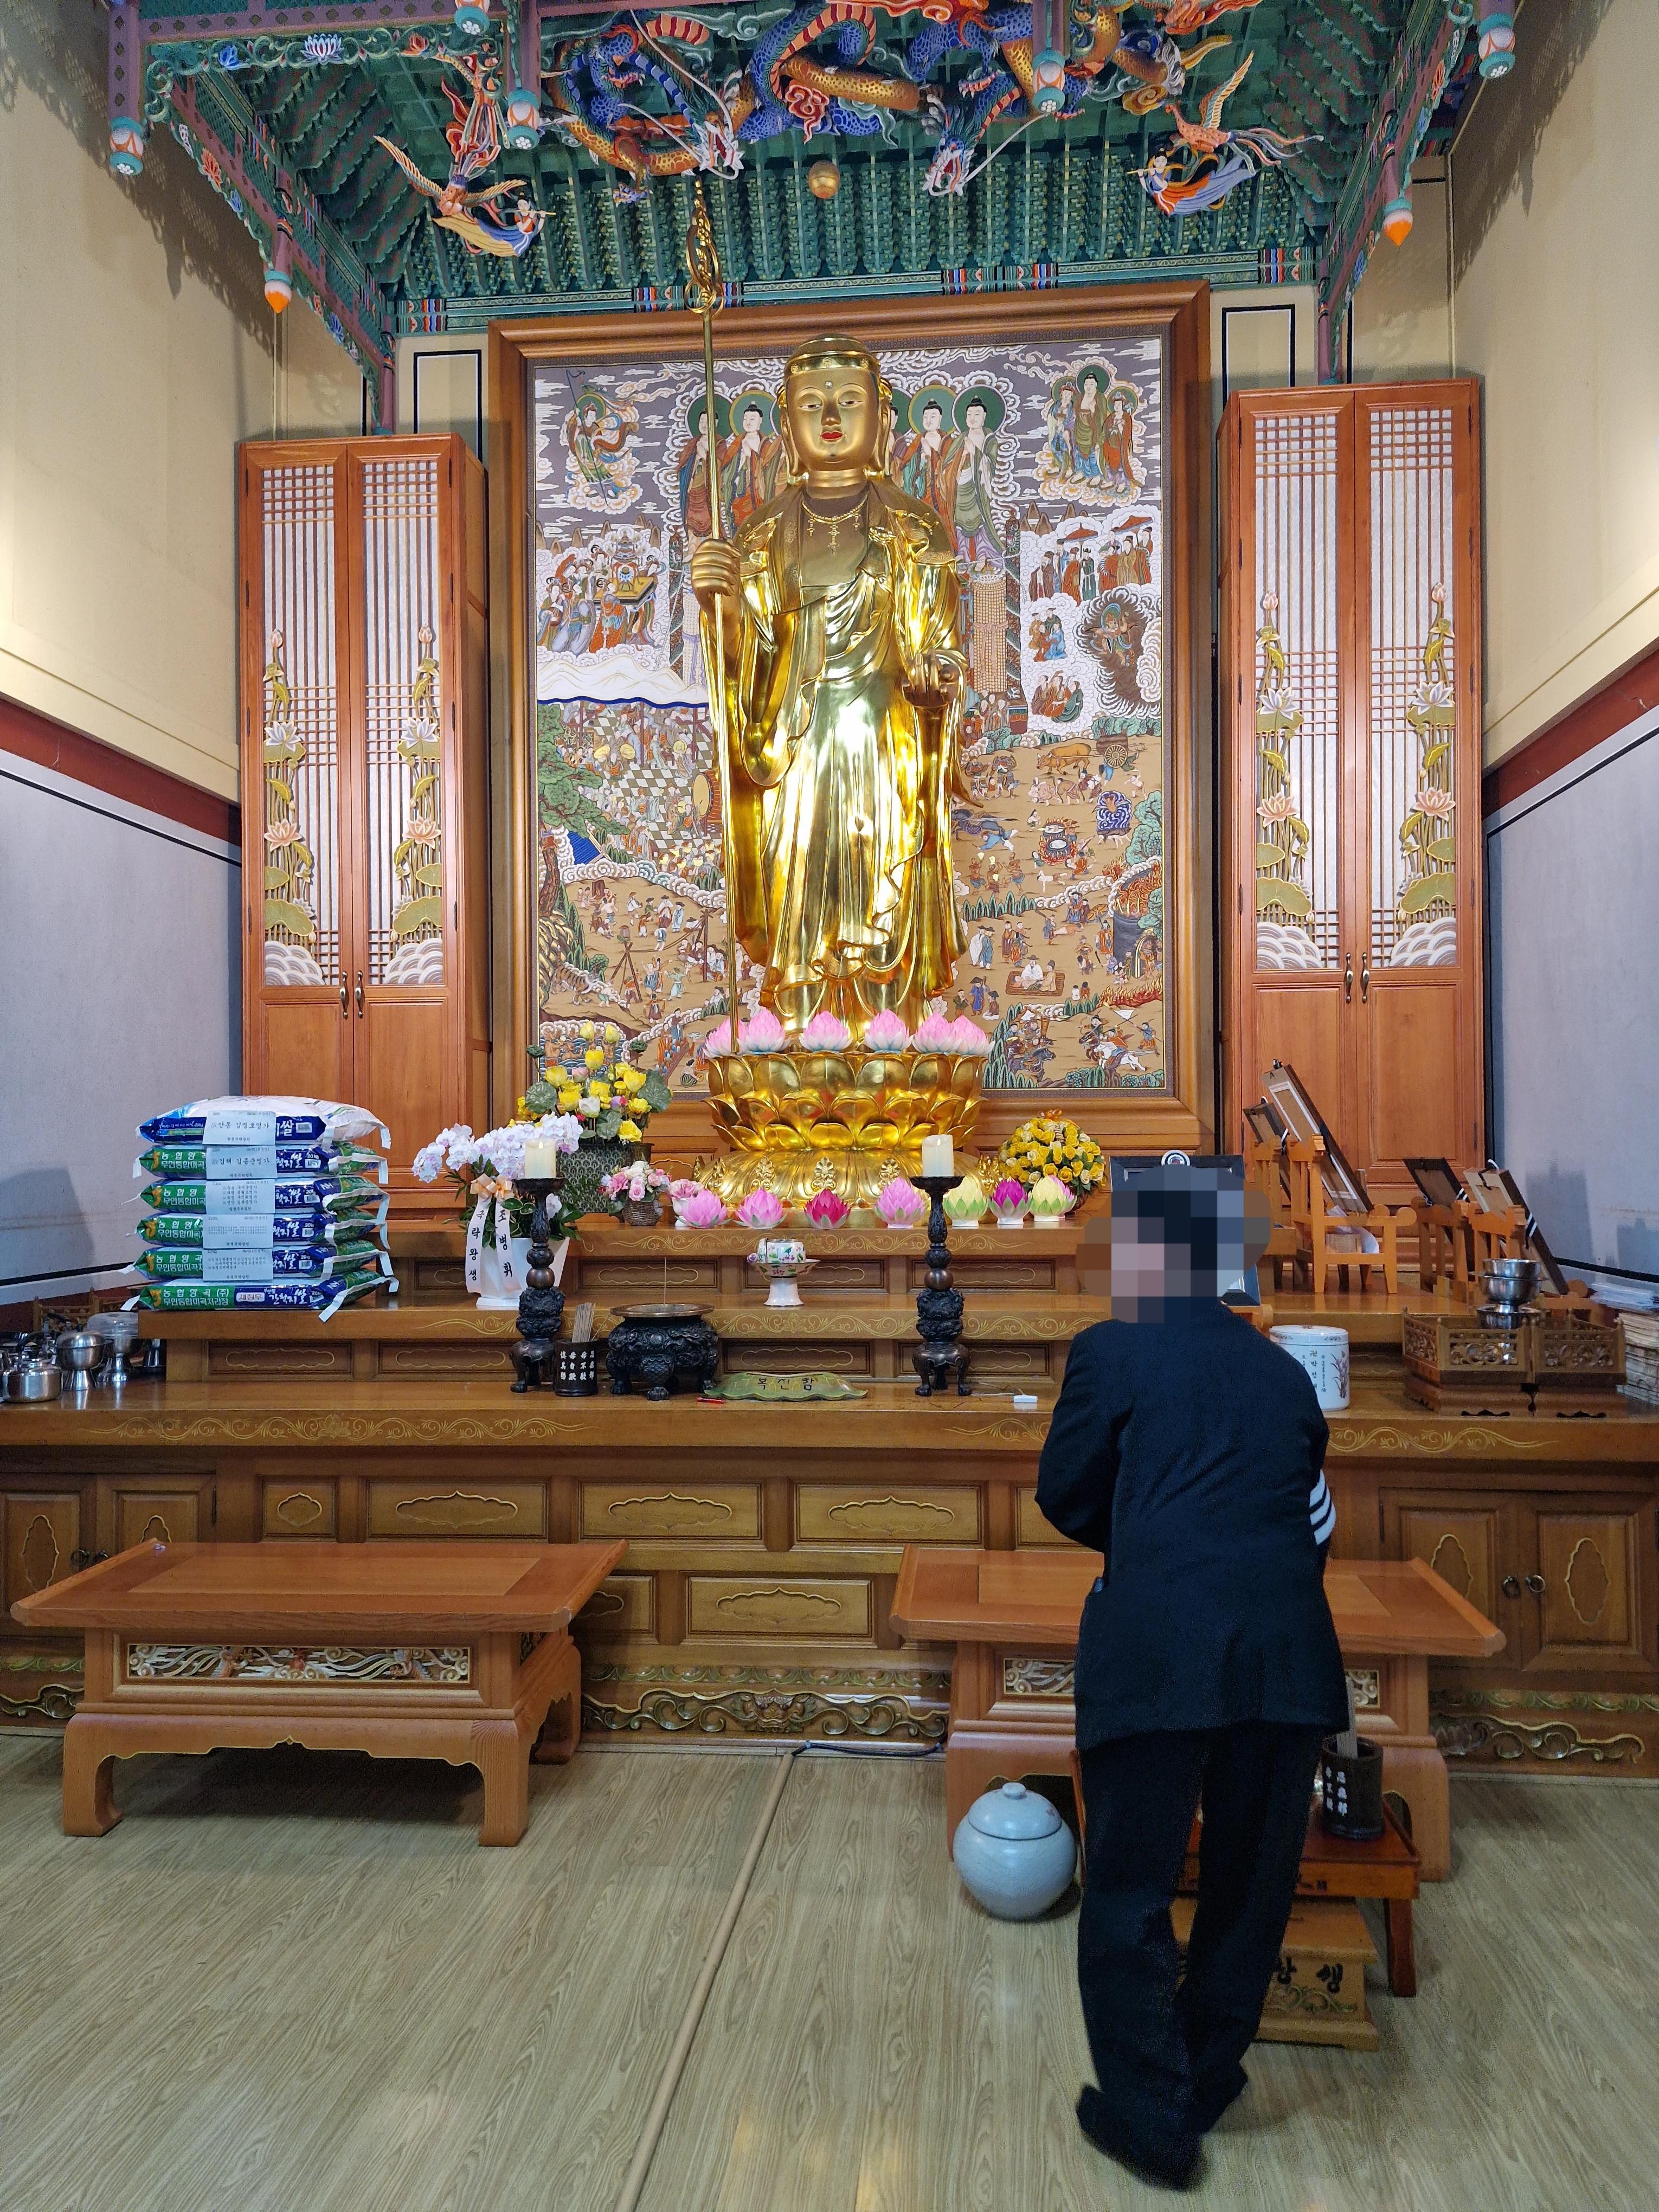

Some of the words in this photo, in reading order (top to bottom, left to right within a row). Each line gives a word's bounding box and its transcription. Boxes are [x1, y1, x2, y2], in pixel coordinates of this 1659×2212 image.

[276, 1120, 294, 1137] 쌀
[158, 1220, 203, 1229] 농협양
[158, 1230, 203, 1238] 무안통합미곡
[468, 1210, 485, 1281] 극락왕생
[498, 1209, 513, 1278] 조병휘
[163, 1289, 211, 1298] 농협양곡
[216, 1288, 229, 1297] (주)
[163, 1297, 229, 1306] 무안통합미곡처리장
